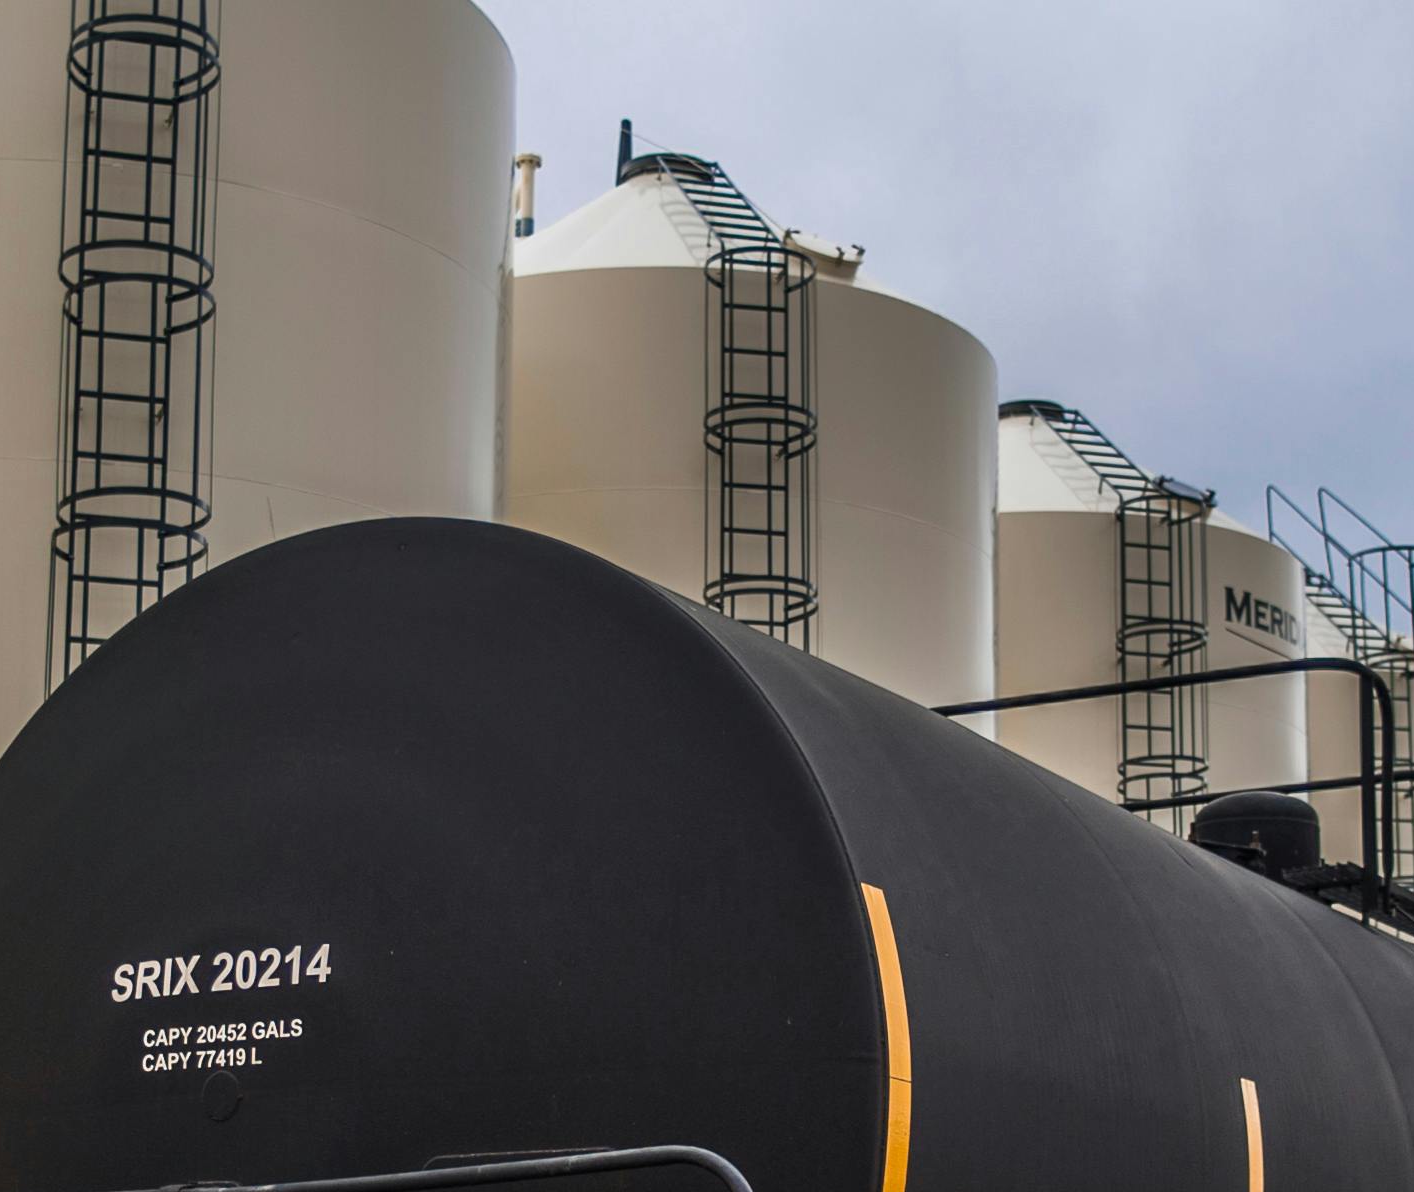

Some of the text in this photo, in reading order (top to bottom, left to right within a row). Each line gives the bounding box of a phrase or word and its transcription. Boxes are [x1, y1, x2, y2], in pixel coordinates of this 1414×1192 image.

[111, 943, 332, 1002] SRIX 20214
[143, 1018, 303, 1047] CAPY 20452 GALS
[142, 1047, 263, 1072] CAPY 77419 L
